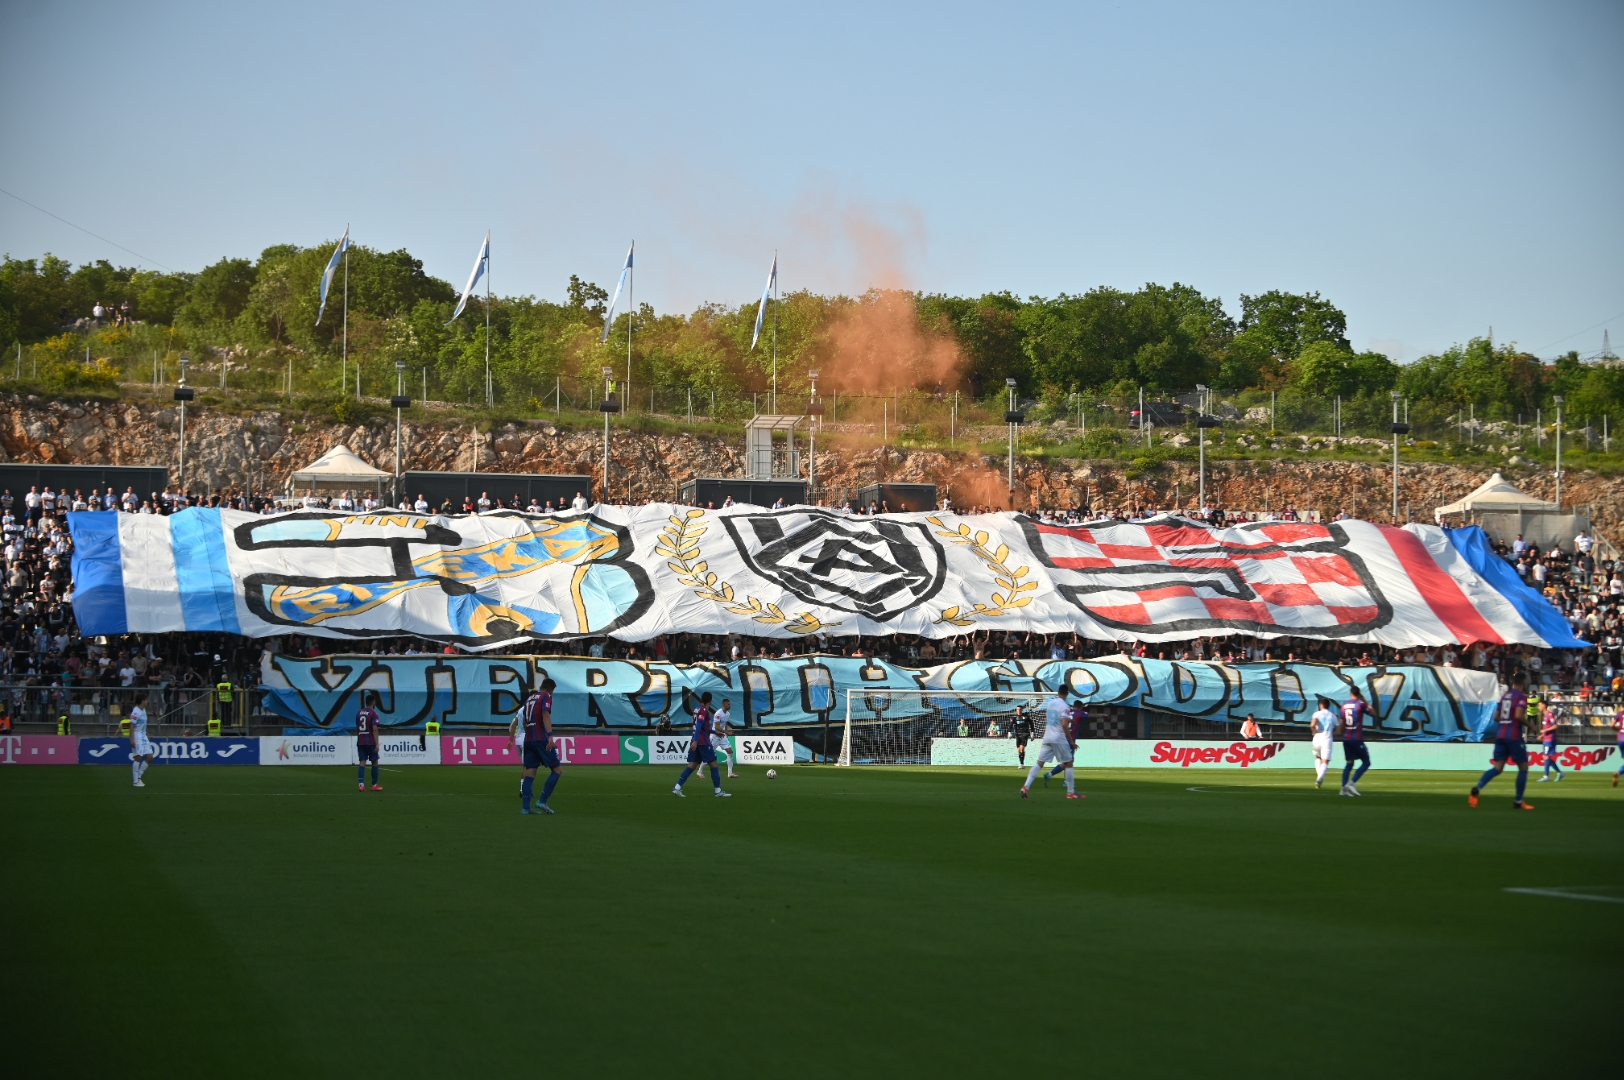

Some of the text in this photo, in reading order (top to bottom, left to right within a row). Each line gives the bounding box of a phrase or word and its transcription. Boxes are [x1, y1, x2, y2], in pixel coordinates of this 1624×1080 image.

[947, 656, 1474, 737] GODINA
[525, 701, 536, 723] 17
[1344, 709, 1353, 726] 6
[359, 716, 367, 731] 3
[293, 742, 335, 752] uniline
[656, 741, 689, 753] SAV
[743, 741, 787, 754] SAVA
